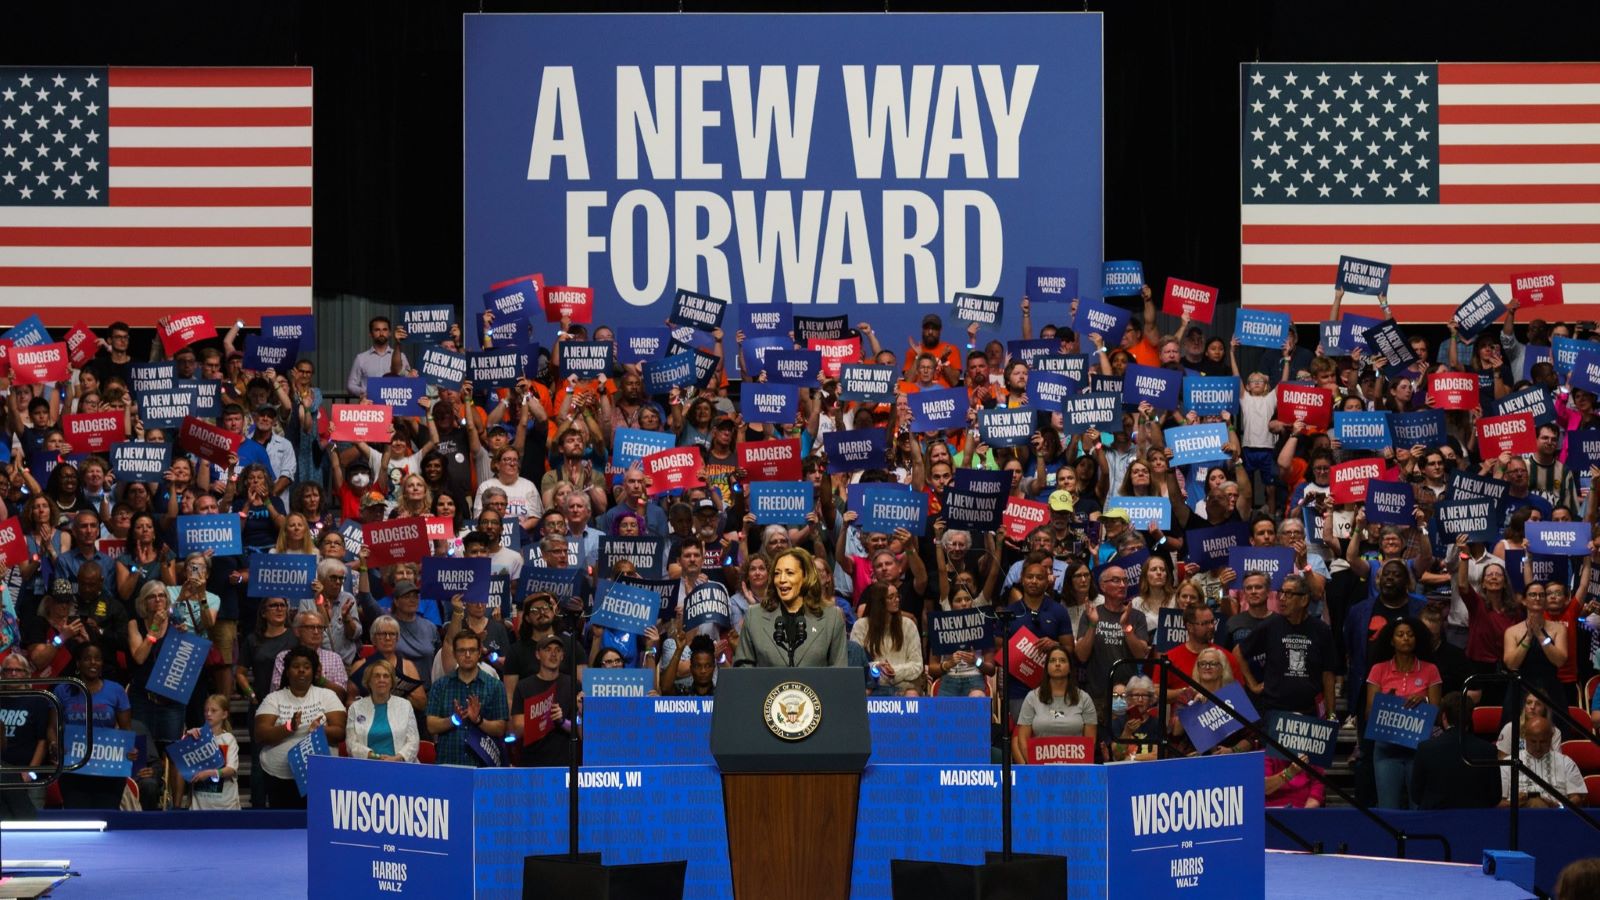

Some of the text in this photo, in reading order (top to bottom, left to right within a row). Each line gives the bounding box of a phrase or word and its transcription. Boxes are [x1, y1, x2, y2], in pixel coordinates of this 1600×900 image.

[527, 65, 1040, 180] A NEW WAY
[565, 190, 1004, 307] FORWARD
[1343, 262, 1386, 278] A NEW WAY
[1038, 277, 1066, 287] HARRIS
[1106, 273, 1141, 285] FREEDOM
[1344, 273, 1381, 289] FORWARD
[1517, 275, 1554, 290] BADGERS
[549, 293, 586, 304] BADGERS
[1172, 285, 1210, 304] BADGERS
[679, 295, 722, 313] A NEW WAY
[957, 298, 999, 312] A NEW WAY
[405, 310, 449, 322] A NEW WAY
[679, 306, 716, 324] FORWARD
[751, 313, 780, 323] HARRIS
[958, 309, 995, 323] FORWARD
[408, 322, 447, 333] FORWARD
[1242, 322, 1282, 336] FREEDOM
[630, 338, 659, 348] HARRIS
[18, 349, 60, 365] BADGERS
[564, 346, 608, 357] A NEW WAY
[470, 357, 477, 368] A
[478, 355, 496, 367] NEW
[498, 354, 516, 366] WAY
[567, 358, 605, 369] FORWARD
[474, 367, 516, 380] FORWARD
[651, 363, 690, 384] FREEDOM
[845, 369, 892, 381] A NEW WAY
[847, 381, 888, 393] FORWARD
[1136, 375, 1167, 391] HARRIS
[1434, 379, 1473, 391] BADGERS
[381, 388, 412, 399] HARRIS
[1139, 387, 1161, 397] WALZ
[1191, 389, 1233, 403] FREEDOM
[1283, 389, 1324, 407] BADGERS
[143, 395, 150, 406] A
[151, 394, 170, 405] NEW
[172, 393, 191, 404] WAY
[385, 398, 407, 406] WALZ
[754, 394, 786, 406] HARRIS
[1067, 398, 1115, 412] A NEW WAY
[147, 406, 189, 419] FORWARD
[759, 405, 781, 413] WALZ
[922, 400, 955, 414] HARRIS
[340, 410, 384, 422] BADGERS
[928, 411, 951, 420] WALZ
[983, 411, 1032, 425] A NEW WAY
[1071, 410, 1113, 424] FORWARD
[72, 418, 116, 433] BADGERS
[987, 425, 1029, 438] FORWARD
[1342, 424, 1384, 437] FREEDOM
[1395, 423, 1438, 439] FREEDOM
[1483, 420, 1526, 438] BADGERS
[189, 424, 232, 451] BADGERS
[1175, 436, 1221, 453] FREEDOM
[115, 448, 166, 460] A NEW WAY
[746, 446, 792, 462] BADGERS
[839, 440, 872, 454] HARRIS
[651, 453, 694, 472] BADGERS
[845, 452, 869, 461] WALZ
[118, 460, 161, 472] FORWARD
[1335, 464, 1379, 482] BADGERS
[758, 496, 804, 510] FREEDOM
[947, 494, 996, 509] A NEW WAY
[1374, 491, 1405, 506] HARRIS
[873, 505, 920, 521] FREEDOM
[948, 507, 993, 521] FORWARD
[1125, 507, 1162, 519] REEDOM
[1378, 504, 1401, 513] WALZ
[1440, 503, 1489, 519] A NEW WAY
[1444, 518, 1487, 532] FORWARD
[187, 528, 233, 543] FREEDOM
[371, 525, 419, 543] BADGERS
[1541, 531, 1576, 541] HARRIS
[1244, 558, 1279, 572] HARRIS
[258, 569, 308, 585] FREEDOM
[438, 570, 474, 582] HARRIS
[443, 582, 468, 590] WALZ
[686, 598, 691, 609] A
[691, 587, 711, 603] NEW
[603, 597, 650, 620] FREEDOM
[687, 603, 727, 619] FORWARD
[934, 614, 986, 630] A NEW WAY
[939, 627, 983, 644] FORWARD
[1282, 637, 1312, 645] WISCONSIN
[164, 640, 194, 690] FREEDOM
[655, 700, 714, 714] MADISON, WI
[868, 700, 919, 714] ADISON, WI
[1197, 700, 1234, 728] HARRS
[1376, 710, 1425, 733] FREEDOM
[1276, 719, 1333, 740] A NEW WAY
[1278, 732, 1326, 754] FORWARD
[72, 742, 123, 761] FREDOM
[1036, 744, 1086, 760] BADGERS
[626, 771, 641, 787] WI
[940, 770, 997, 788] MADISON,
[330, 789, 449, 840] WISCONSIN
[1131, 786, 1243, 836] WISCONSIN
[373, 860, 407, 882] HARRIS
[1171, 857, 1203, 877] HARRIS
[378, 881, 402, 892] WALZ
[1176, 877, 1198, 888] WALZ
